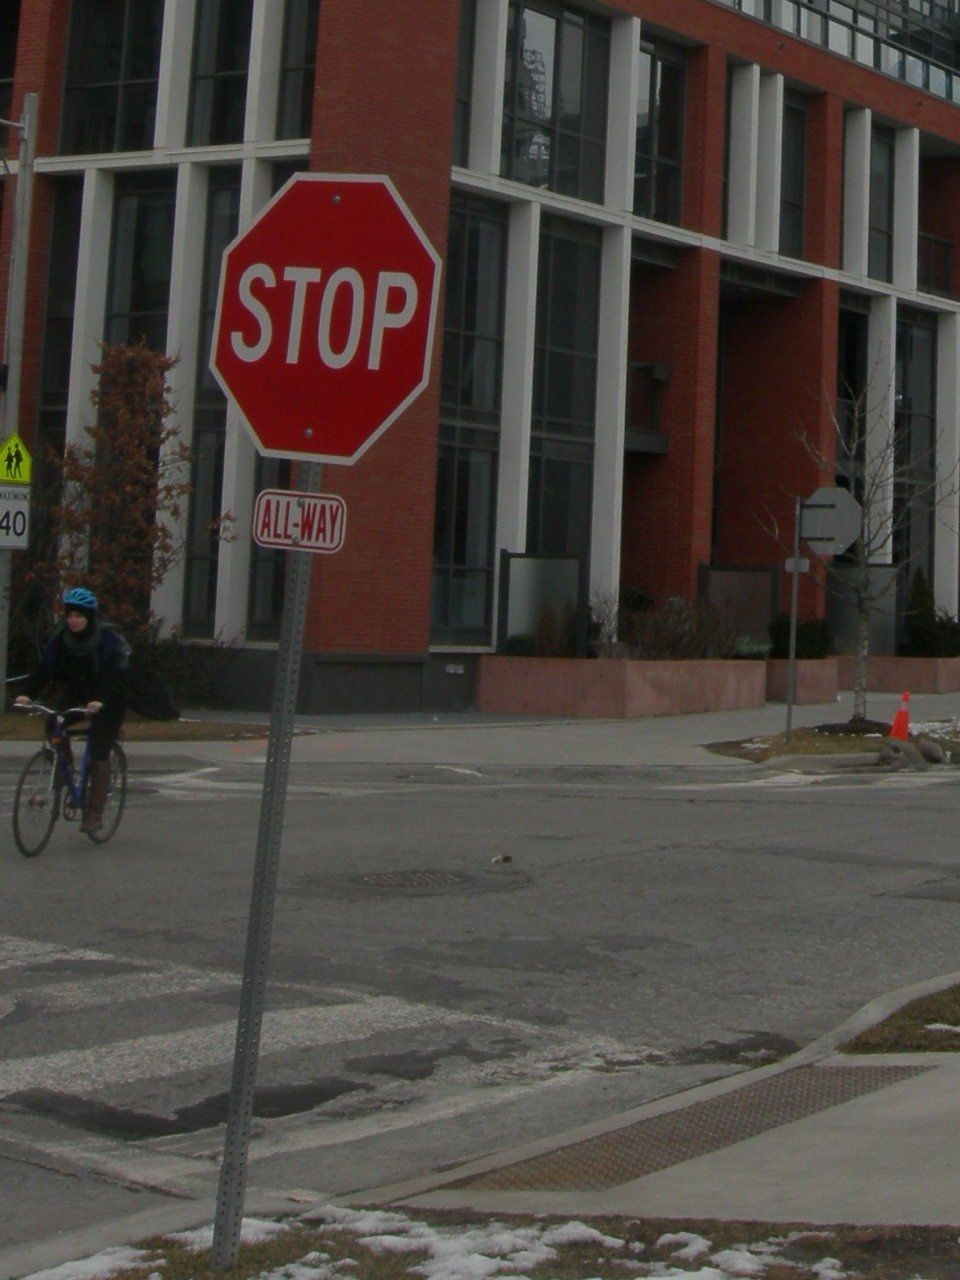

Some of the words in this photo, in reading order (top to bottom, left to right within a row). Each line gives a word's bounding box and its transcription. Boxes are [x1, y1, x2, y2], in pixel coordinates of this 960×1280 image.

[230, 263, 418, 370] STOP
[0, 510, 26, 537] 40
[260, 498, 340, 543] ALL-WAY
